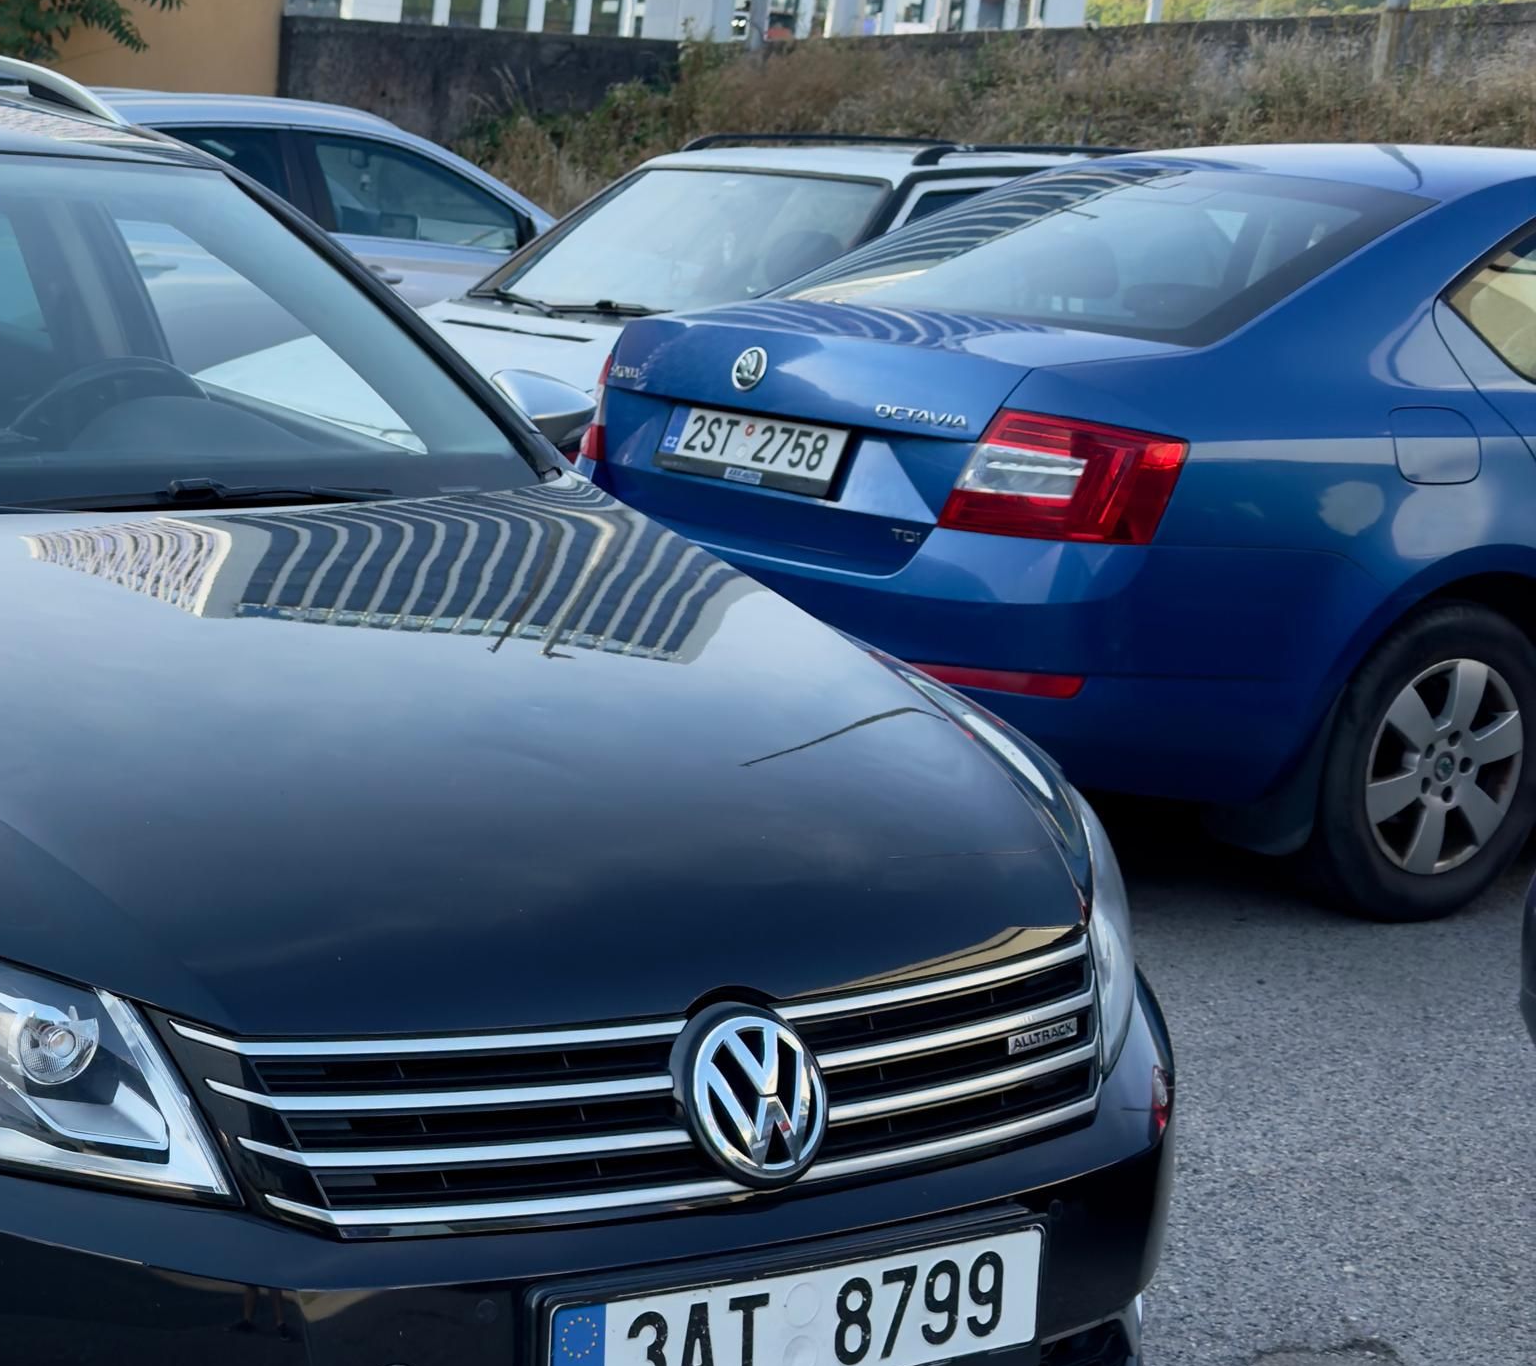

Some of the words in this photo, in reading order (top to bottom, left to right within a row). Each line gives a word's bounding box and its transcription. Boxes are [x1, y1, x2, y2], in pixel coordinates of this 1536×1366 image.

[874, 403, 968, 428] OCTAVIA
[683, 414, 741, 456] 2ST
[750, 425, 830, 472] 2758
[1013, 1021, 1075, 1050] ALLTRACK
[833, 1250, 1005, 1366] 8799
